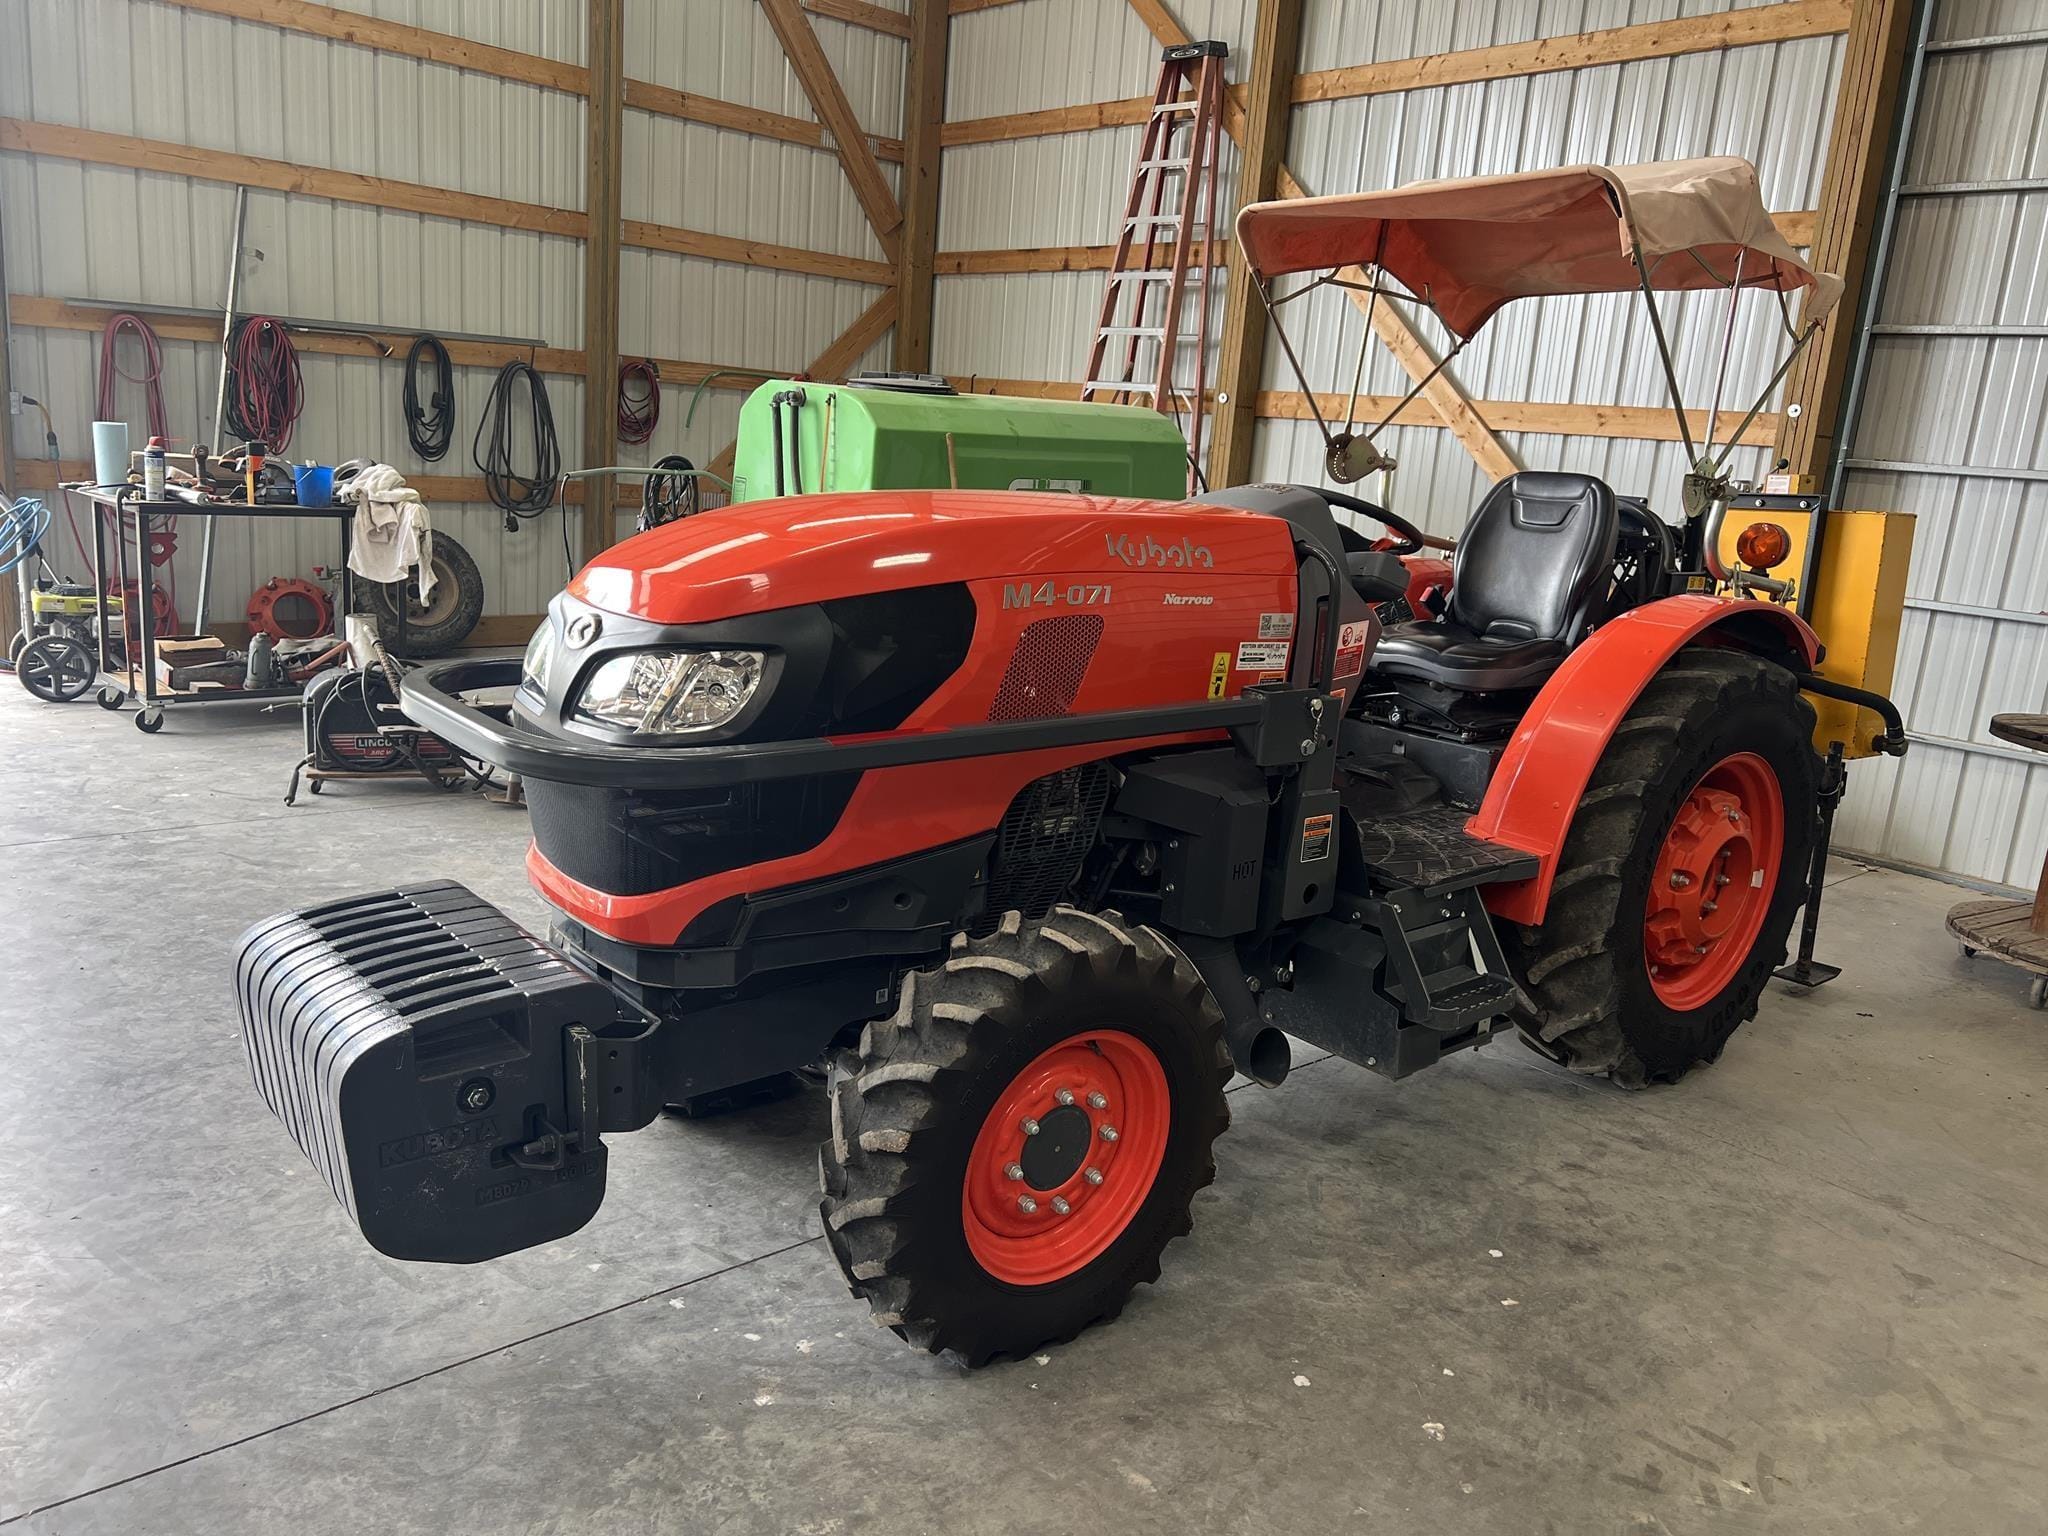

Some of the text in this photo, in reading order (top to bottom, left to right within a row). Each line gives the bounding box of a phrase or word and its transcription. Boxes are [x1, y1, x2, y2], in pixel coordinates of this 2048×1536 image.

[1105, 533, 1213, 568] Kubota
[1002, 581, 1112, 610] M4-071
[1163, 593, 1214, 606] Narrow
[358, 738, 402, 748] LINCO
[1232, 860, 1257, 880] HOT
[382, 1118, 499, 1167] KUBOTA
